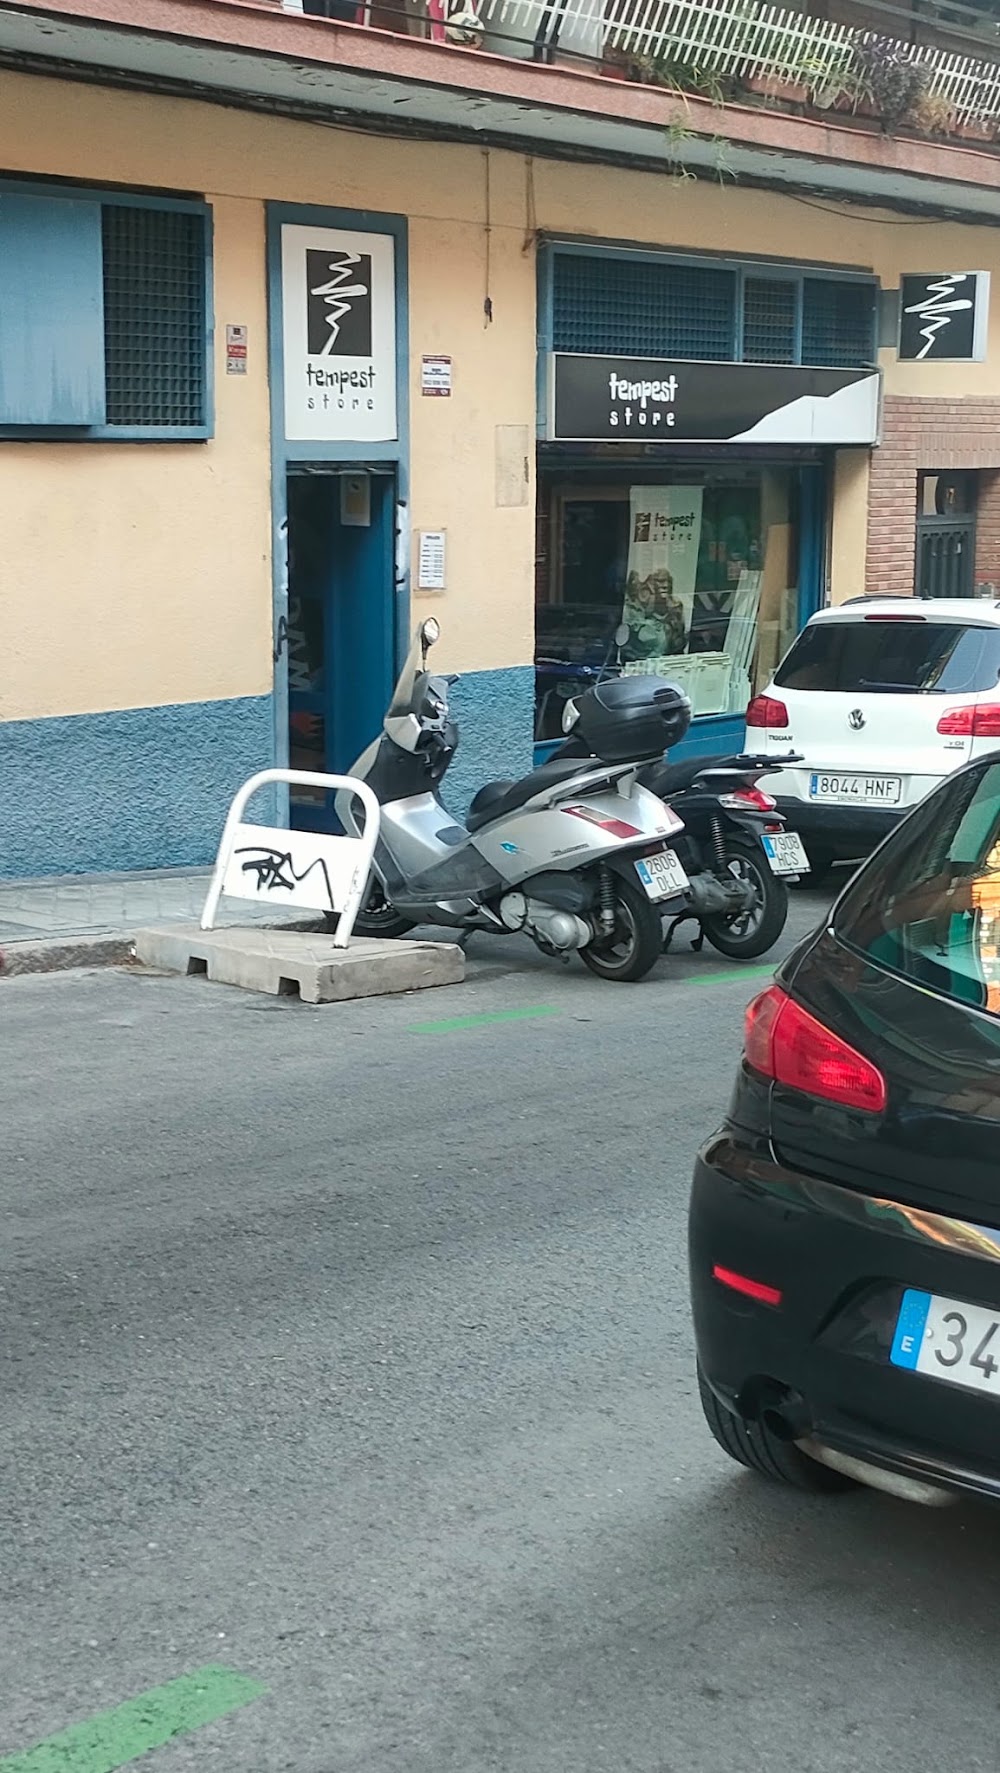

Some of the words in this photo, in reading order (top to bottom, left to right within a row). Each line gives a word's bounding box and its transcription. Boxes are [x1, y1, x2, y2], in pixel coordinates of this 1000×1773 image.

[306, 363, 376, 394] tempest
[609, 372, 679, 408] tempest
[307, 394, 375, 410] store
[609, 407, 676, 427] store
[654, 512, 696, 531] tempest
[820, 777, 859, 794] 8044
[865, 779, 895, 797] HNF
[768, 835, 800, 851] 7908
[645, 853, 677, 875] 2606
[776, 851, 800, 867] HCS
[656, 872, 683, 892] DLL
[901, 1335, 915, 1353] E
